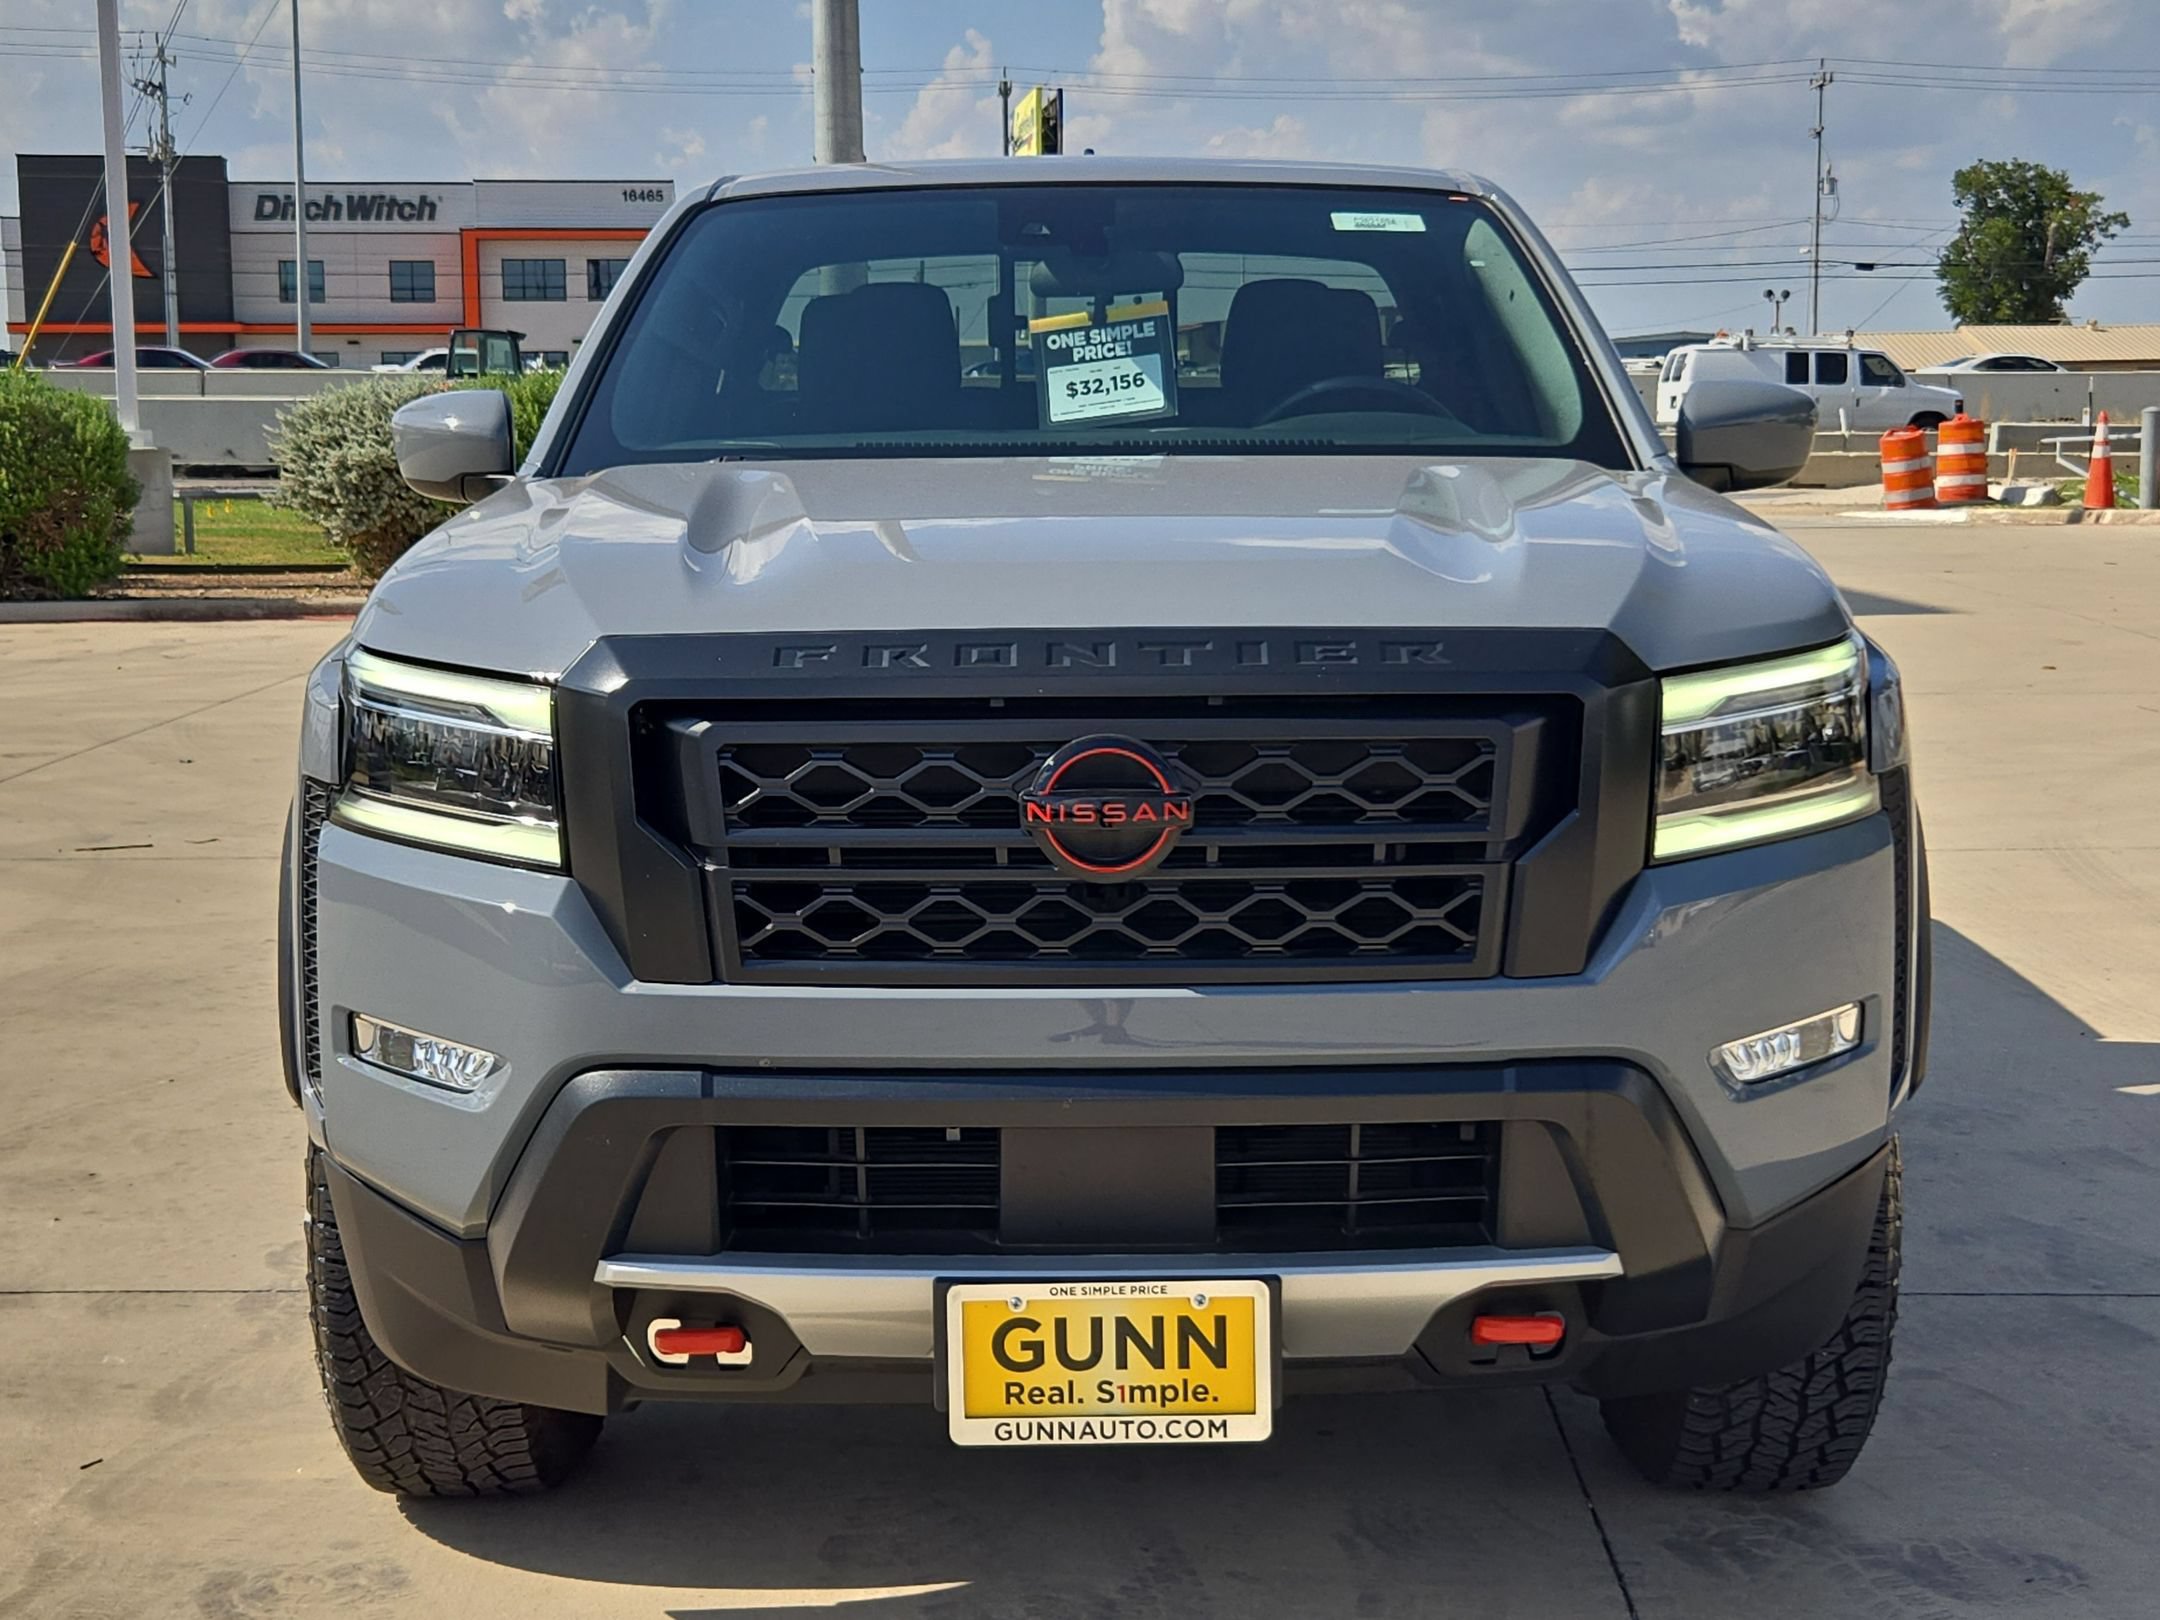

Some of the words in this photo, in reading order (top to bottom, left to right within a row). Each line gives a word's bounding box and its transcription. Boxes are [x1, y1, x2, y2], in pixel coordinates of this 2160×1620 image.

[346, 194, 437, 221] Witch
[622, 189, 664, 202] 16465
[1046, 330, 1087, 350] ONE
[1089, 321, 1156, 345] SIMPLE
[1072, 341, 1133, 362] PRICE!
[1066, 372, 1146, 399] $32,156
[772, 640, 1451, 669] FRONTIER
[1026, 801, 1189, 823] NISSAN
[1049, 1286, 1077, 1296] ONE
[1081, 1286, 1127, 1296] SIMPLE
[1130, 1285, 1168, 1295] PRICE
[991, 1314, 1227, 1372] GUNN
[1004, 1380, 1084, 1406] Real.
[994, 1419, 1228, 1442] GUNNAUTO.COM
